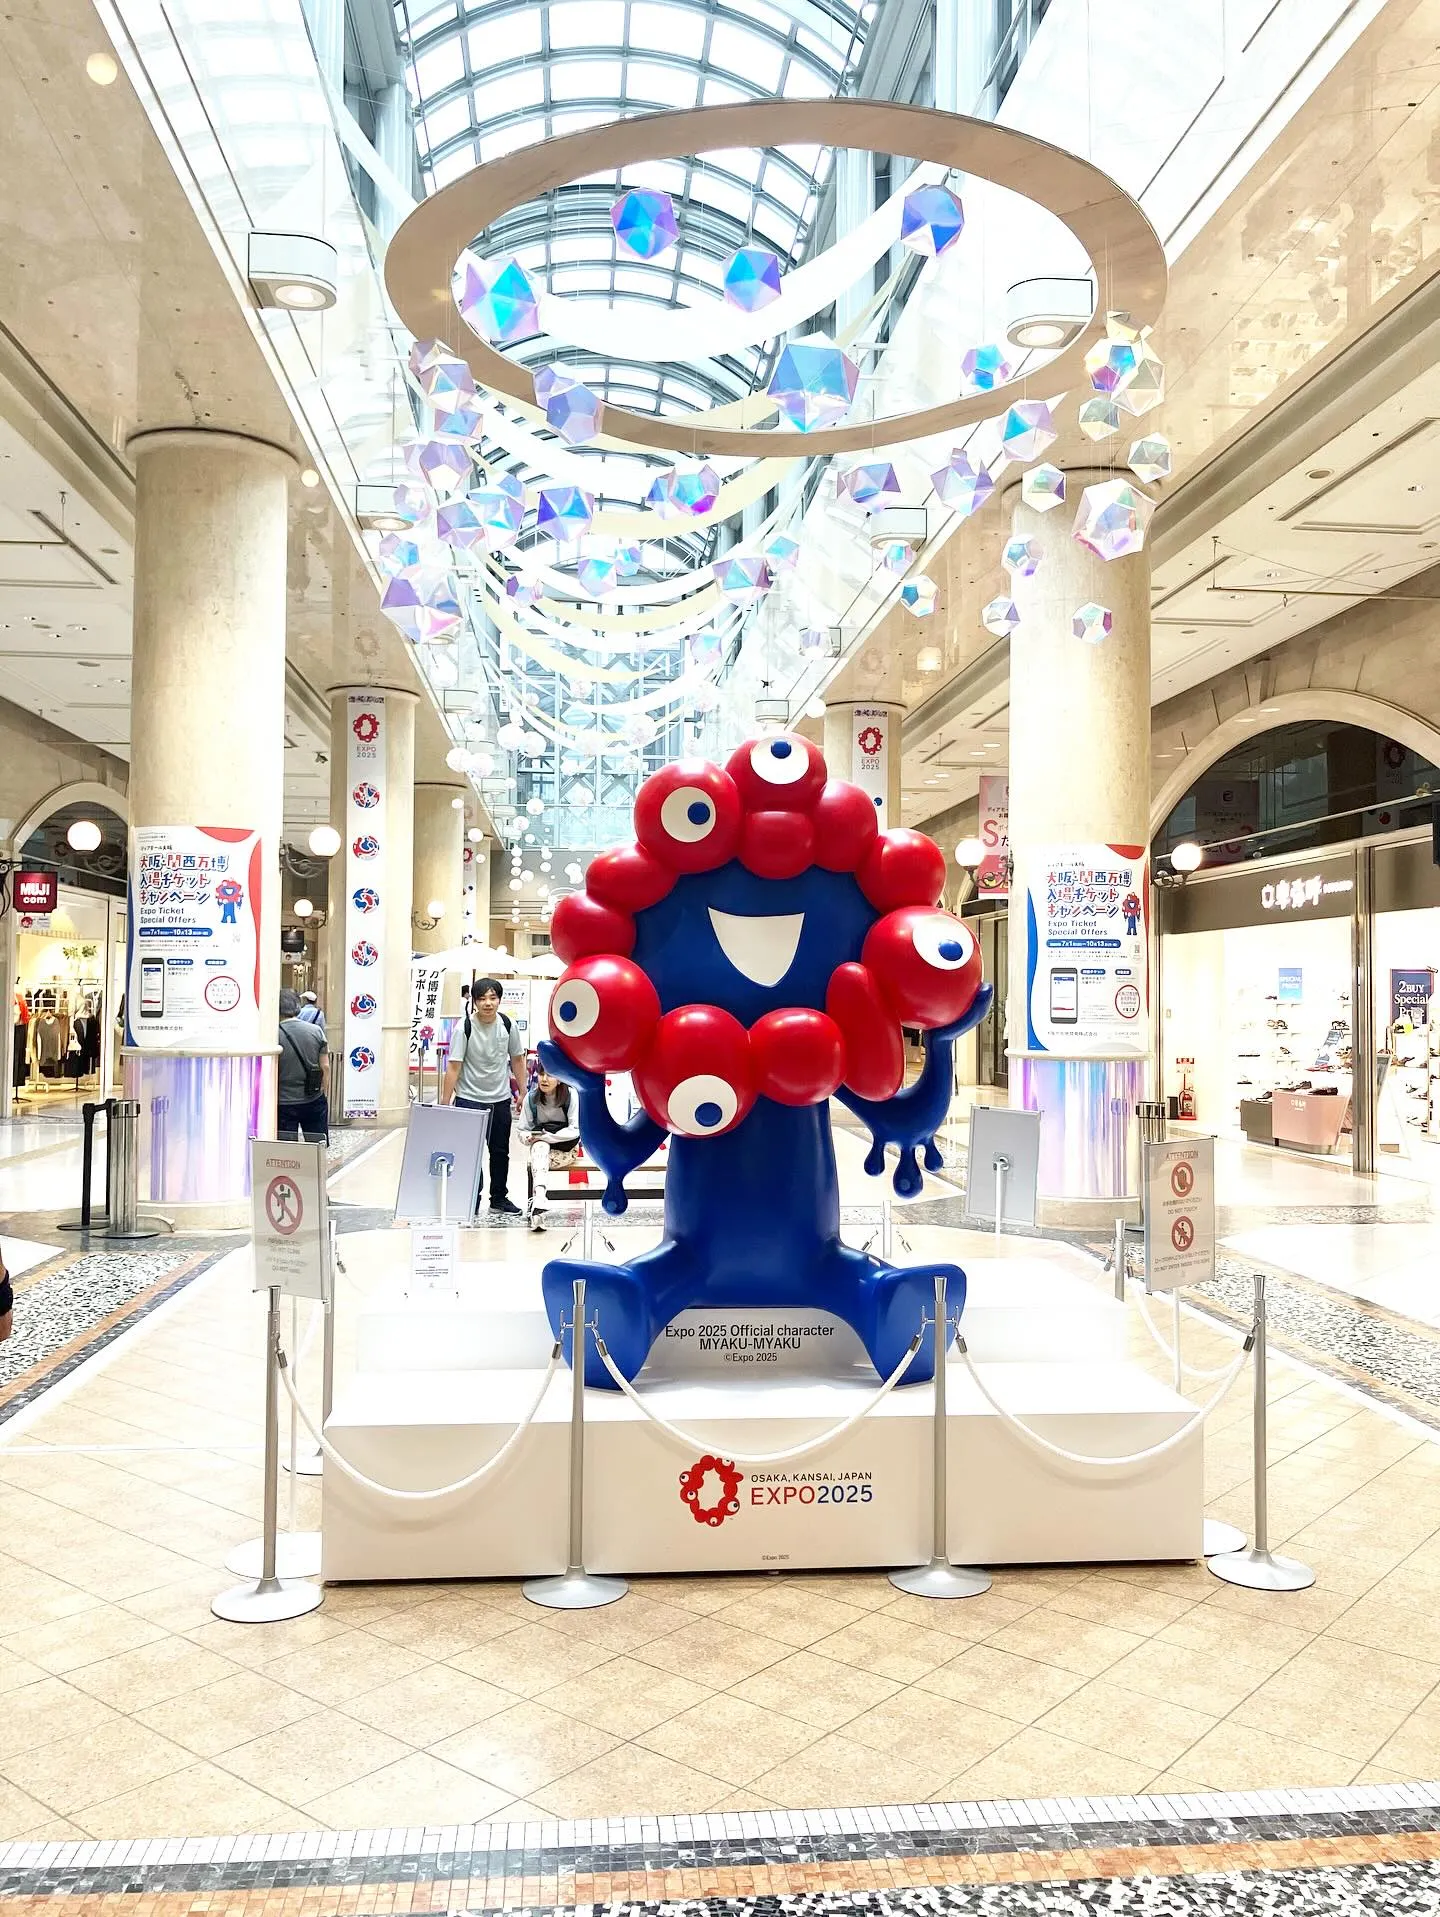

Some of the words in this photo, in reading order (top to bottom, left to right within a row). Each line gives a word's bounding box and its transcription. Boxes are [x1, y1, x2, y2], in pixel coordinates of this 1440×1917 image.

[140, 872, 210, 888] 入場チケット
[20, 883, 50, 895] MUJI
[1048, 888, 1119, 902] 入場チケット
[140, 890, 210, 904] キャンペーン
[1048, 904, 1119, 918] キャンペーン
[1399, 981, 1425, 993] 2BUY
[1394, 994, 1429, 1006] Special
[1166, 1150, 1199, 1161] ATTENTION
[266, 1159, 301, 1169] ATTENTION
[665, 1325, 695, 1339] Expo
[698, 1326, 728, 1336] 2025
[730, 1325, 774, 1336] Official
[777, 1325, 834, 1336] character
[700, 1338, 801, 1350] MYAKU-MYAKU
[756, 1353, 777, 1362] 2025
[751, 1474, 791, 1483] OSAKA,
[793, 1473, 836, 1482] KANSAI,
[838, 1472, 872, 1480] JAPAN
[751, 1485, 872, 1505] EXPO2025
